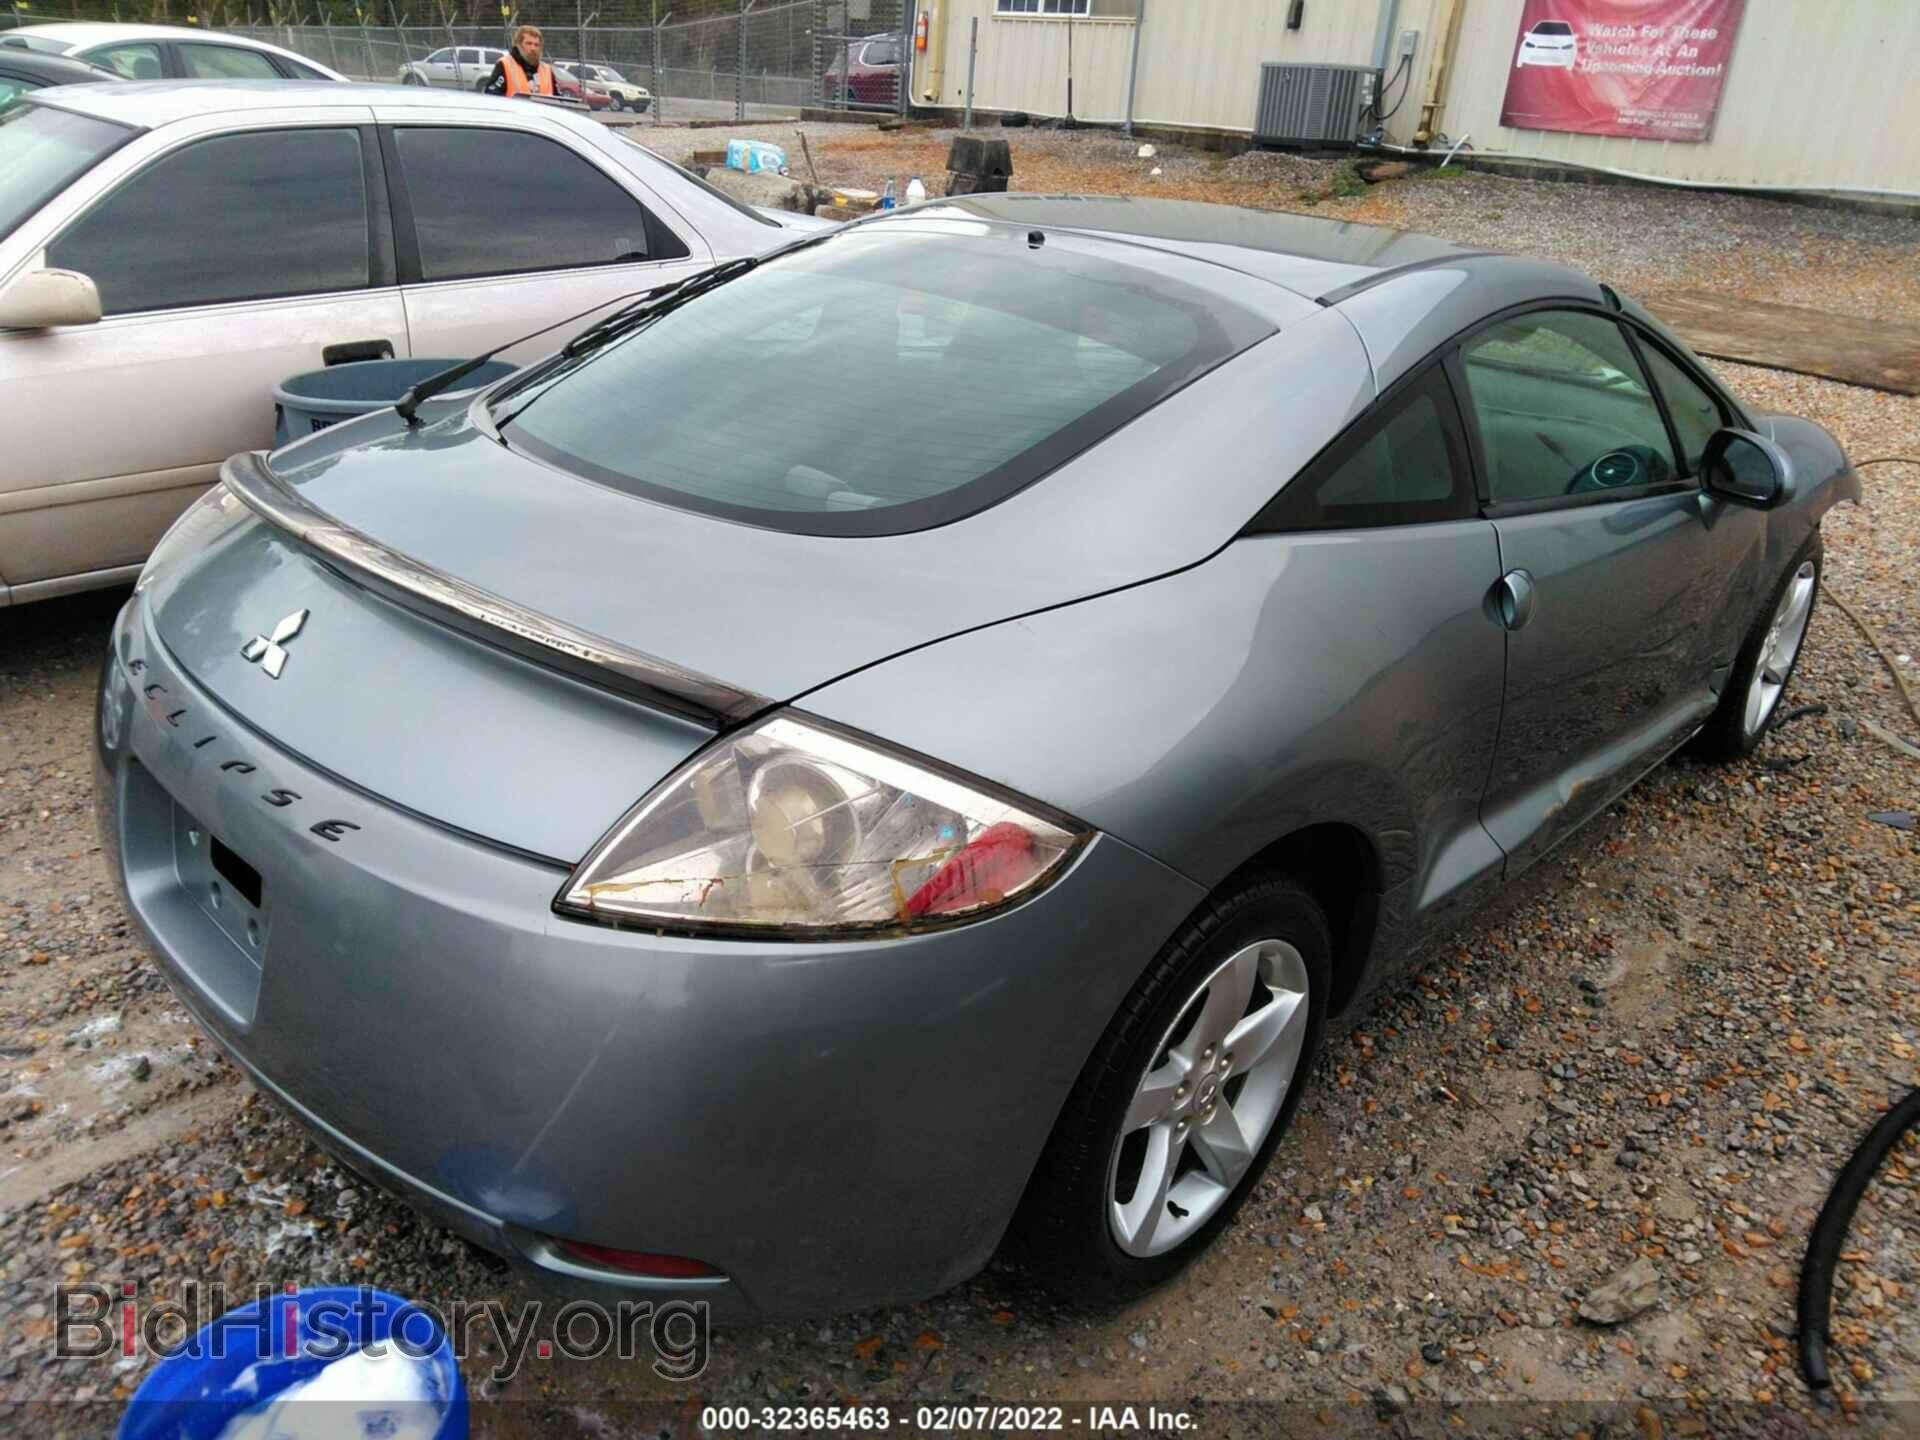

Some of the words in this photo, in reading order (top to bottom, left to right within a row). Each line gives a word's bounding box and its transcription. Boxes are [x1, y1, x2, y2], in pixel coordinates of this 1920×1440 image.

[1588, 24, 1635, 39] Watch
[1641, 25, 1665, 39] For
[1586, 41, 1648, 57] Vehicles
[1654, 43, 1673, 57] At
[1677, 44, 1698, 58] An
[1655, 62, 1722, 77] Auction!
[128, 658, 361, 842] ECLIPSE
